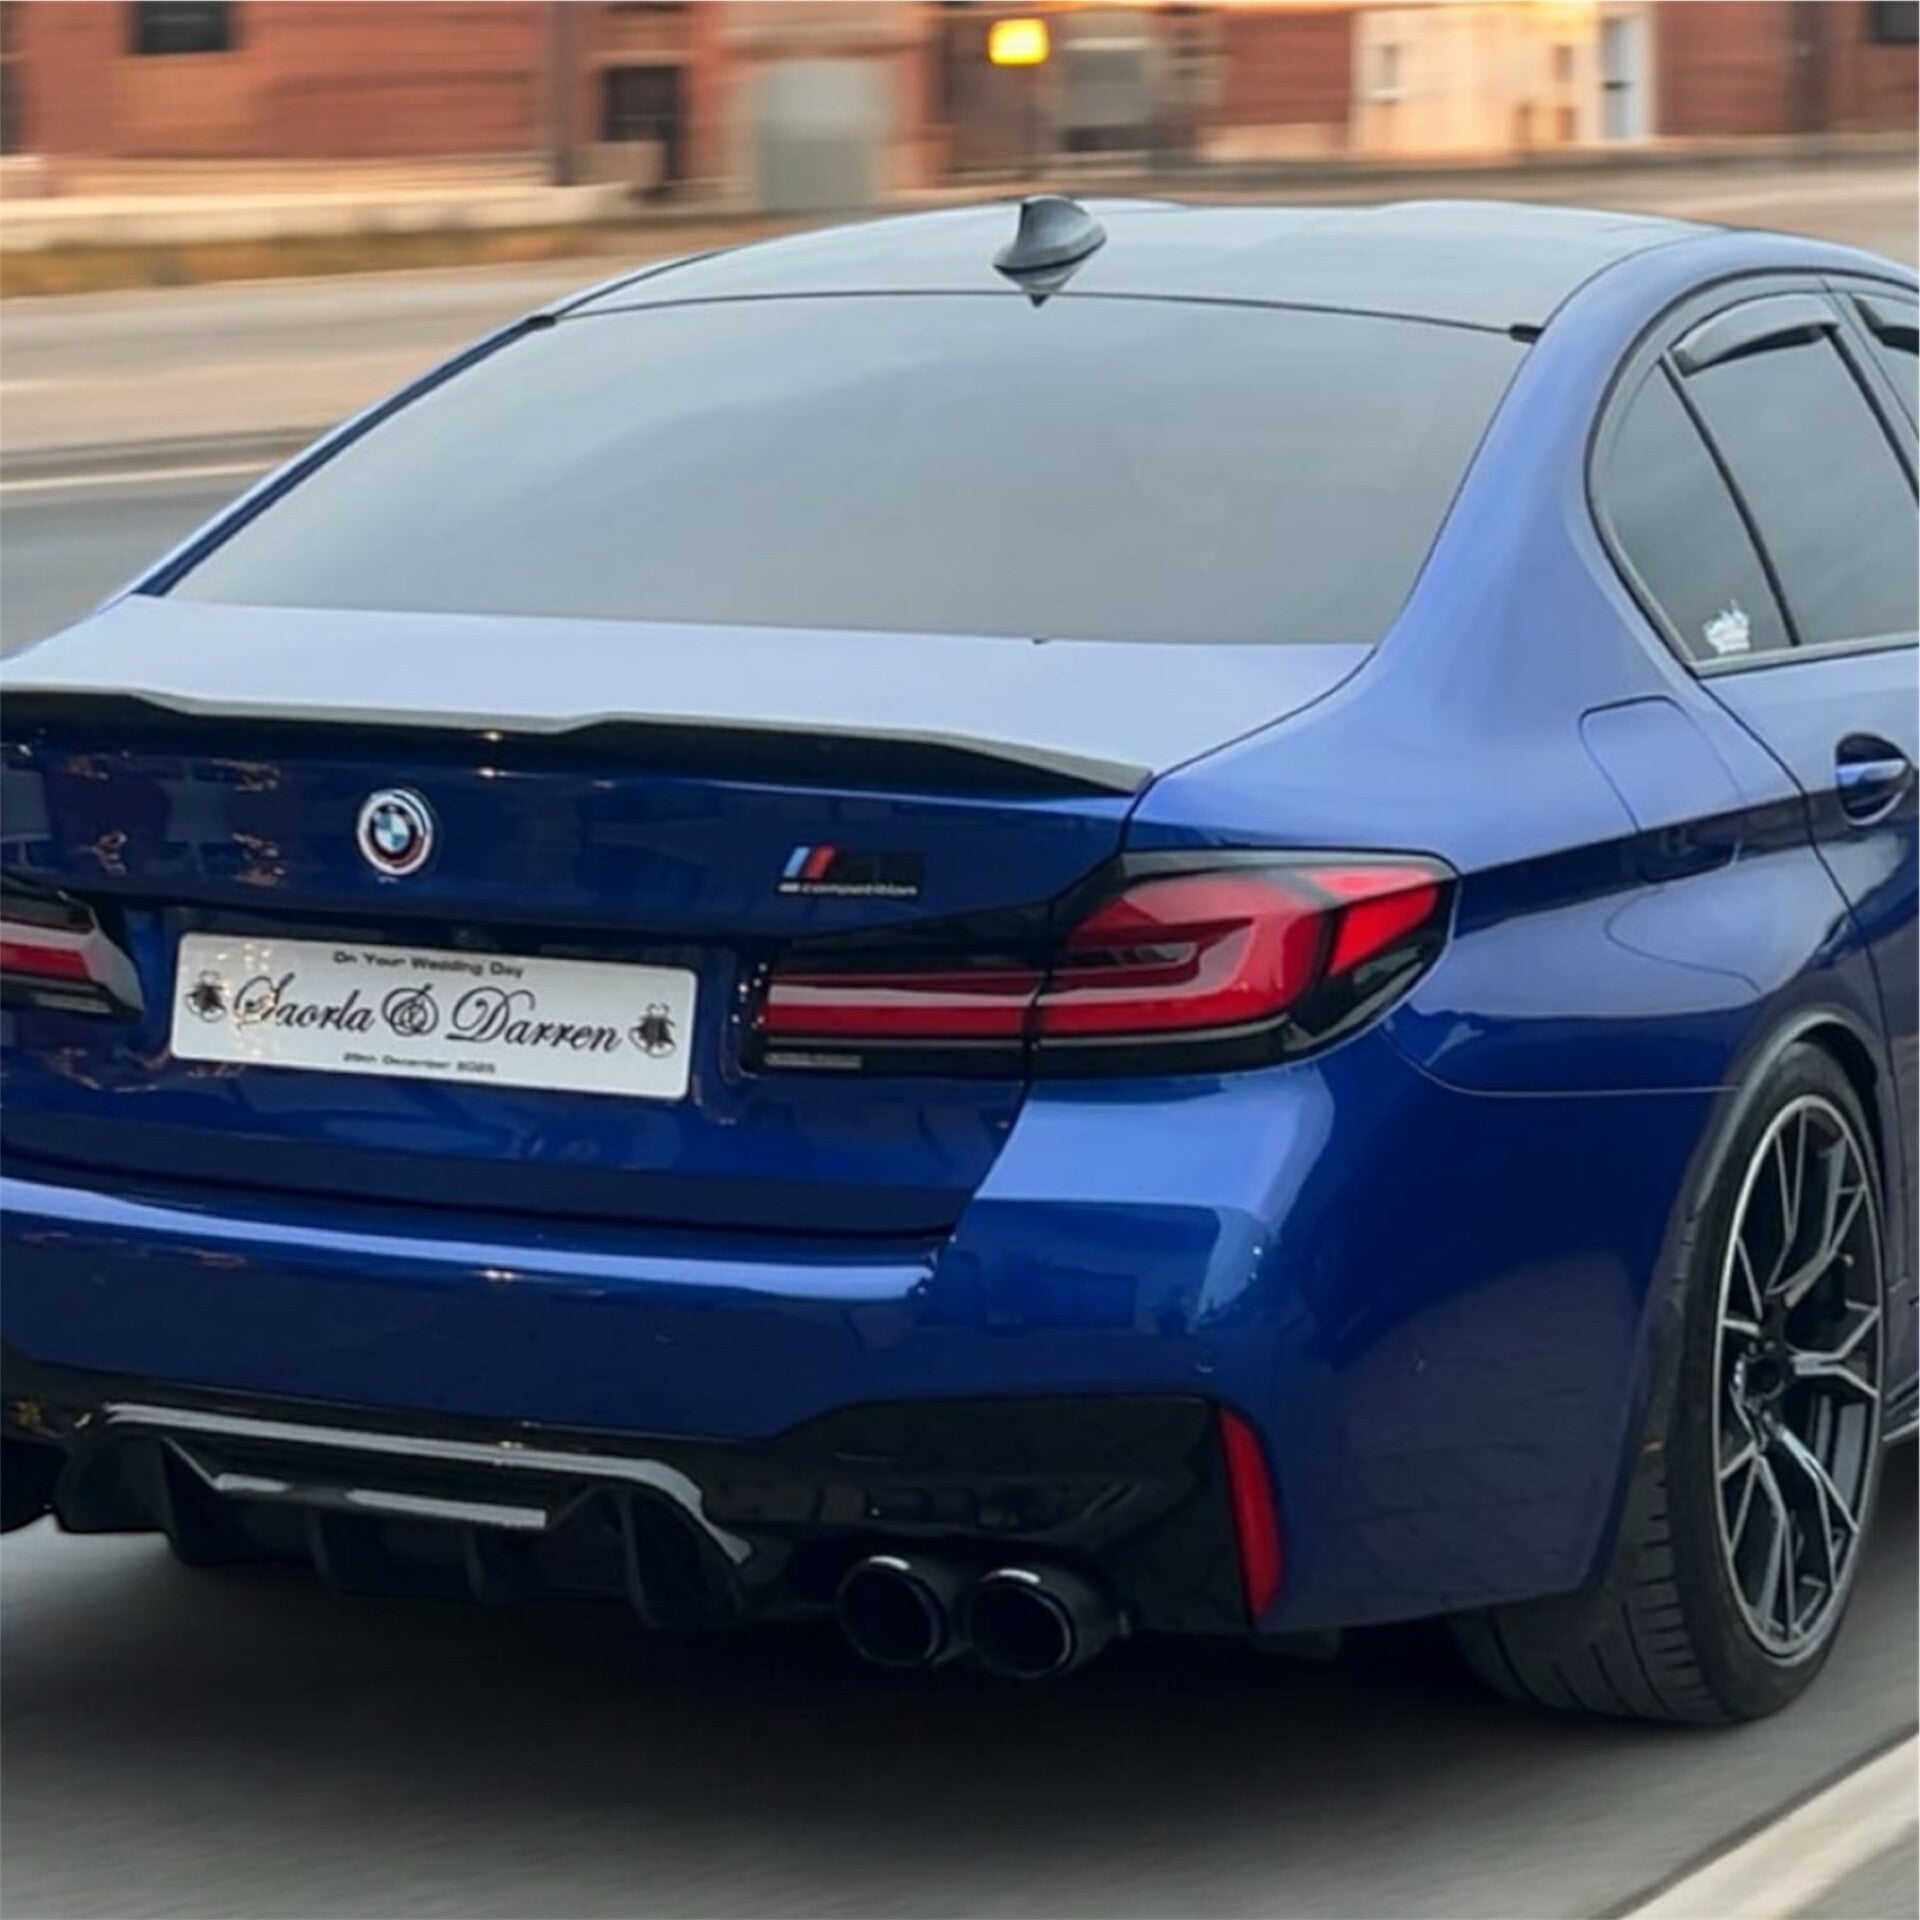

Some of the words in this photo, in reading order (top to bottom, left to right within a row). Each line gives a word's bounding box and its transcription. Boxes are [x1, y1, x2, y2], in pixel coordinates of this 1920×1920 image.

[334, 951, 357, 963] On
[363, 952, 406, 966] Your
[411, 957, 483, 976] Wedding
[490, 961, 523, 978] Day
[382, 983, 438, 1036] &
[445, 986, 622, 1052] Darren
